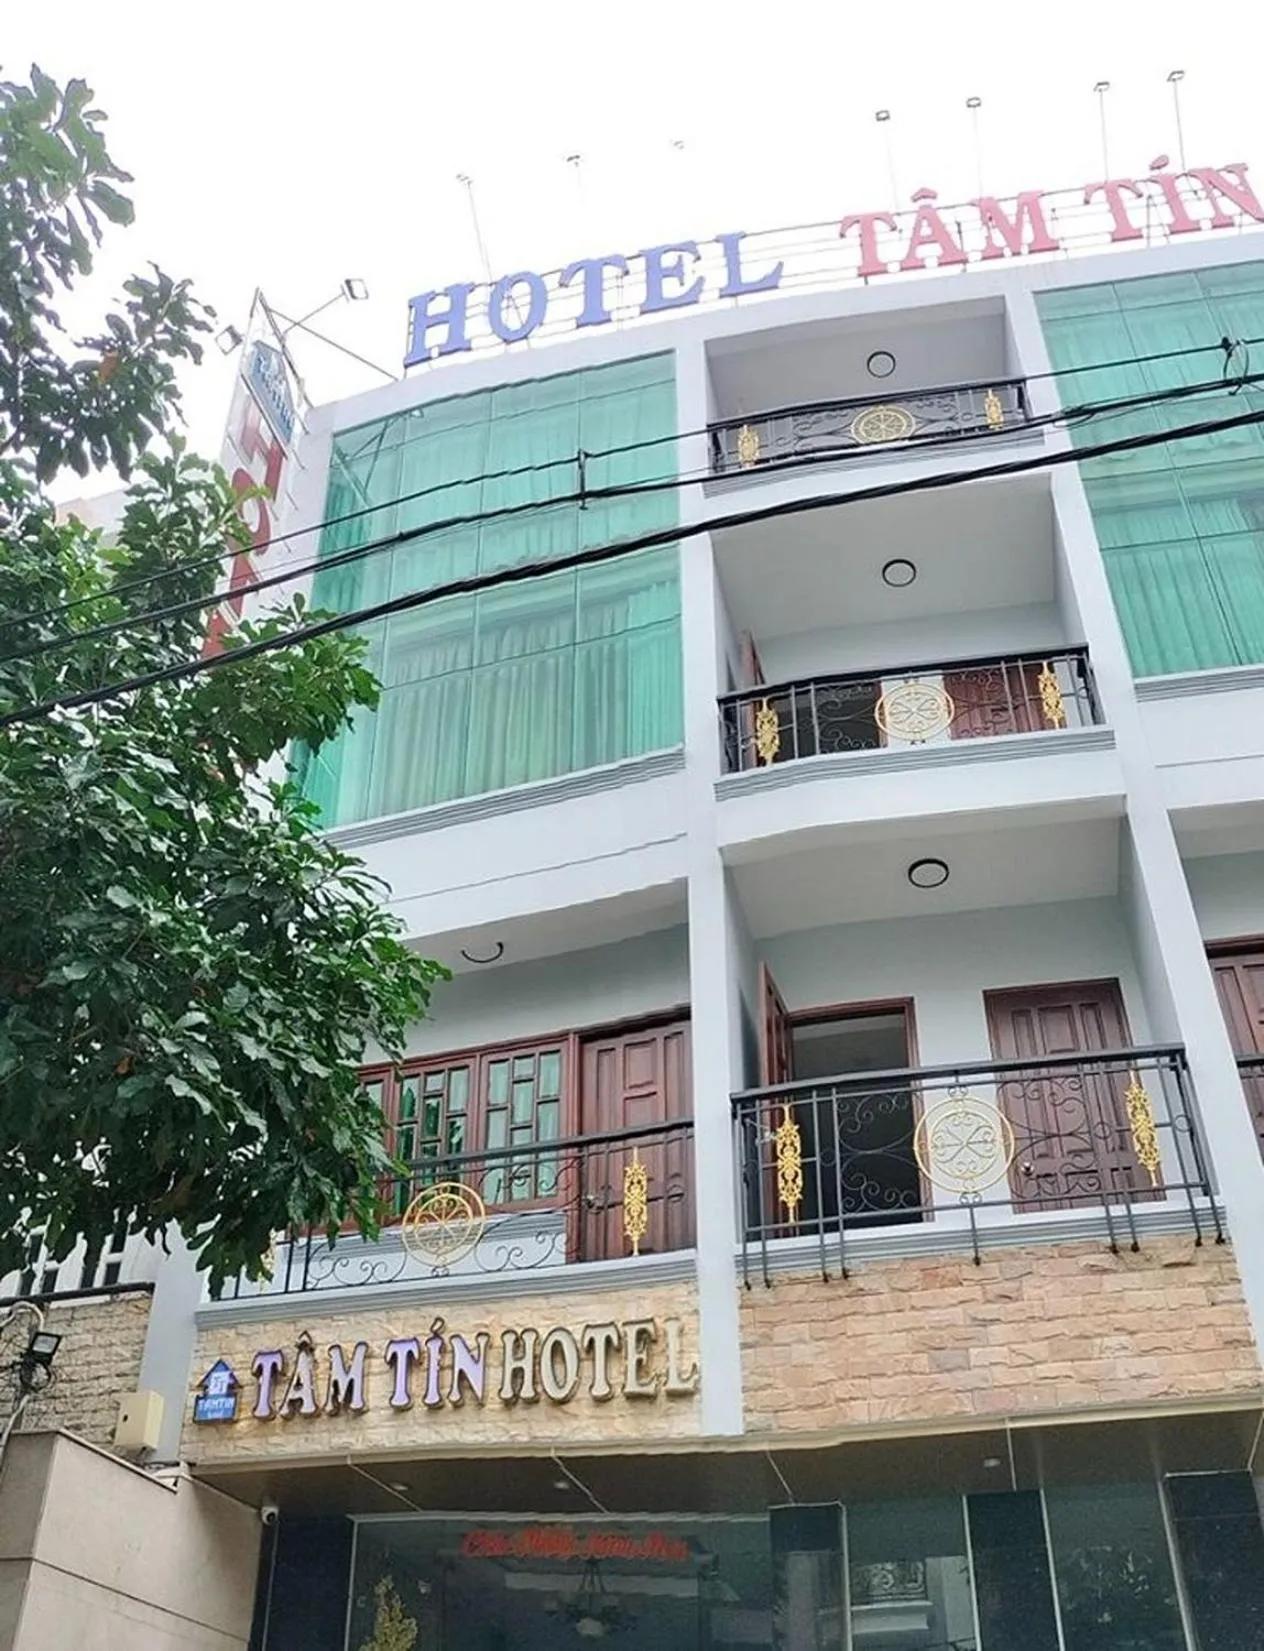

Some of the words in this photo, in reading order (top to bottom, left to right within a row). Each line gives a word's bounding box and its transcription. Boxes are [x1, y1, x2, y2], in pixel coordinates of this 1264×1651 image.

[403, 231, 784, 367] HOTEL
[839, 187, 1060, 278] TÂM
[1083, 154, 1264, 243] TÍN
[250, 1329, 369, 1420] TÂM
[385, 1316, 490, 1413] TÍN
[500, 1317, 699, 1405] HOTEL
